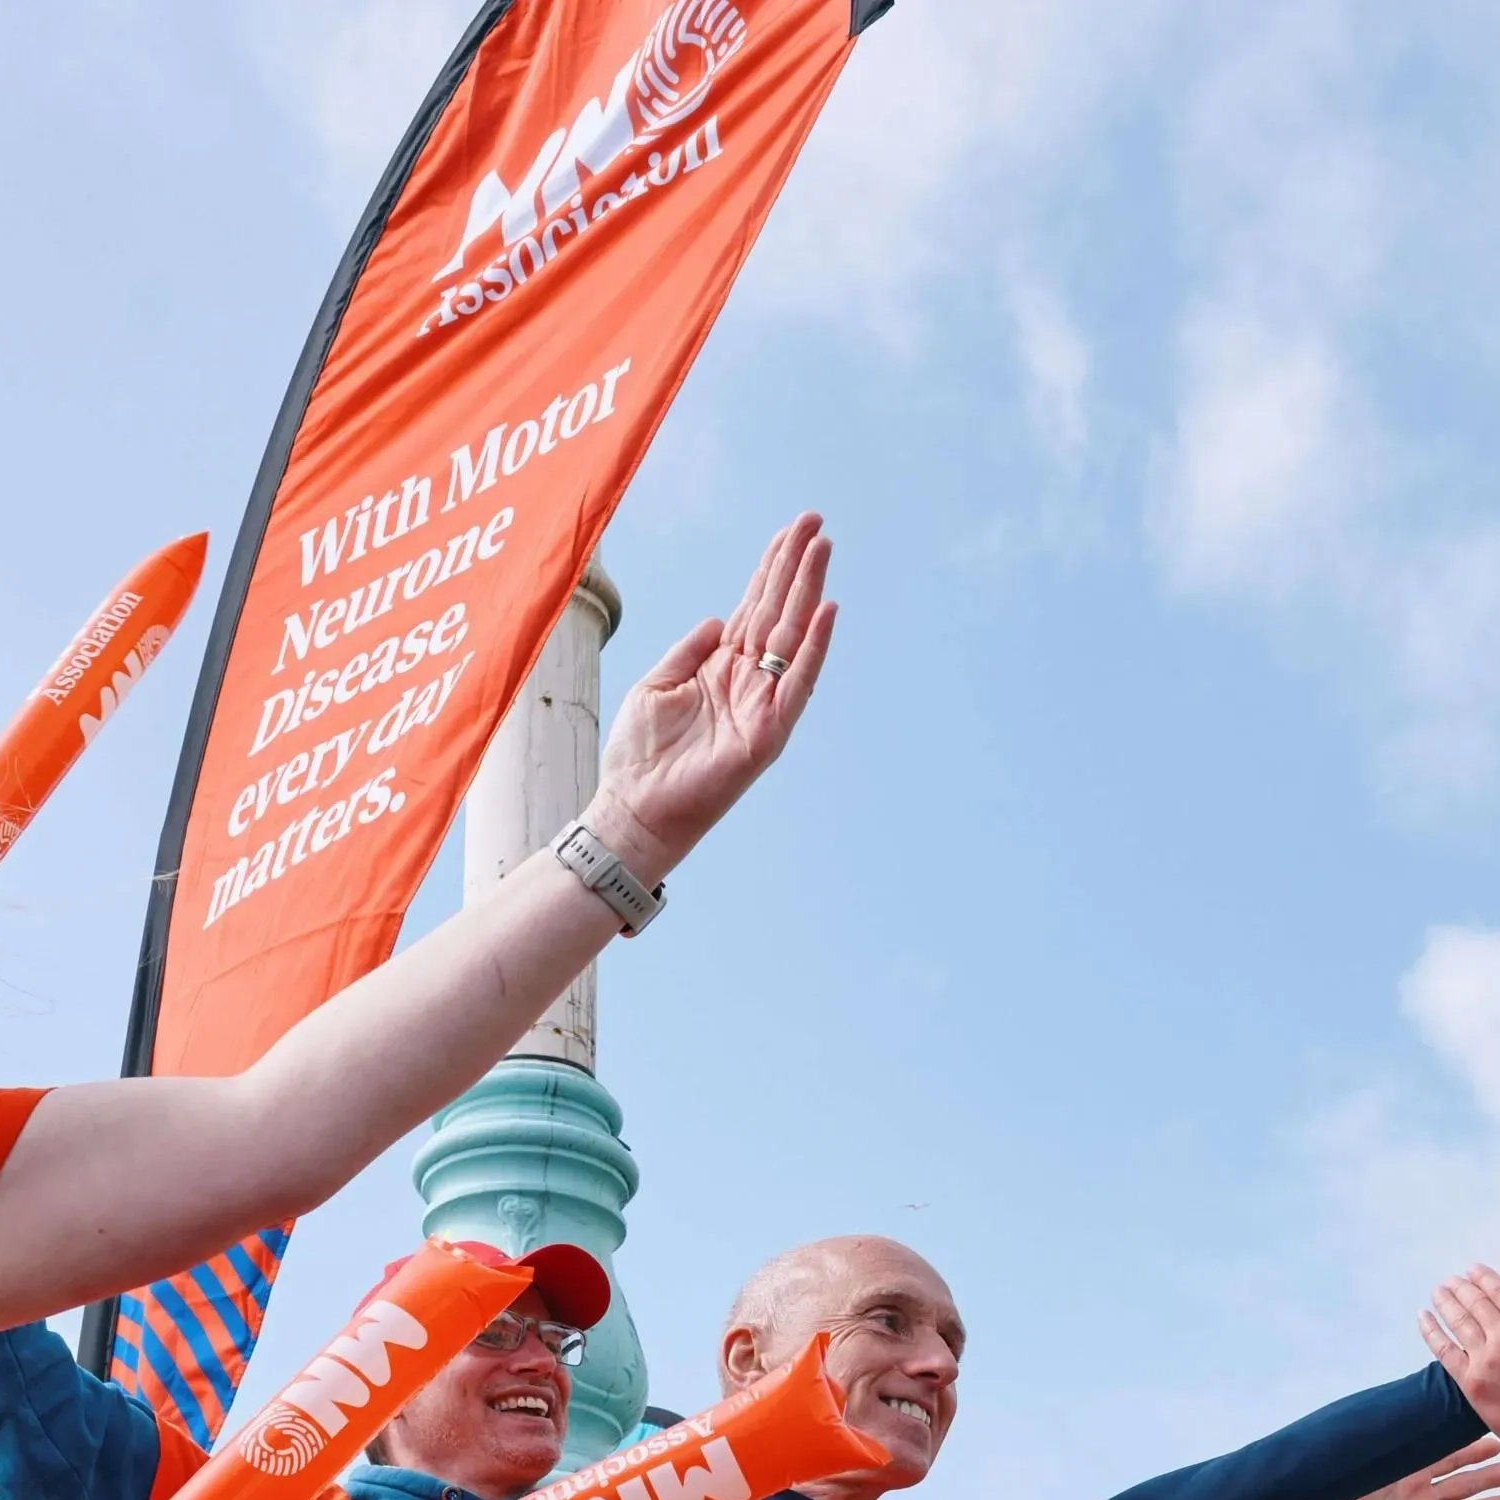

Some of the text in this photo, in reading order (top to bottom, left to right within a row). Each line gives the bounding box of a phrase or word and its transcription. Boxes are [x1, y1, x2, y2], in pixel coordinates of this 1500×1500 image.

[299, 357, 632, 588] With Motor
[41, 590, 145, 707] Association
[271, 505, 514, 676] Neurone
[228, 650, 476, 837] every day
[247, 602, 470, 758] Disease,
[202, 766, 407, 931] matters.
[238, 1299, 429, 1477] MND
